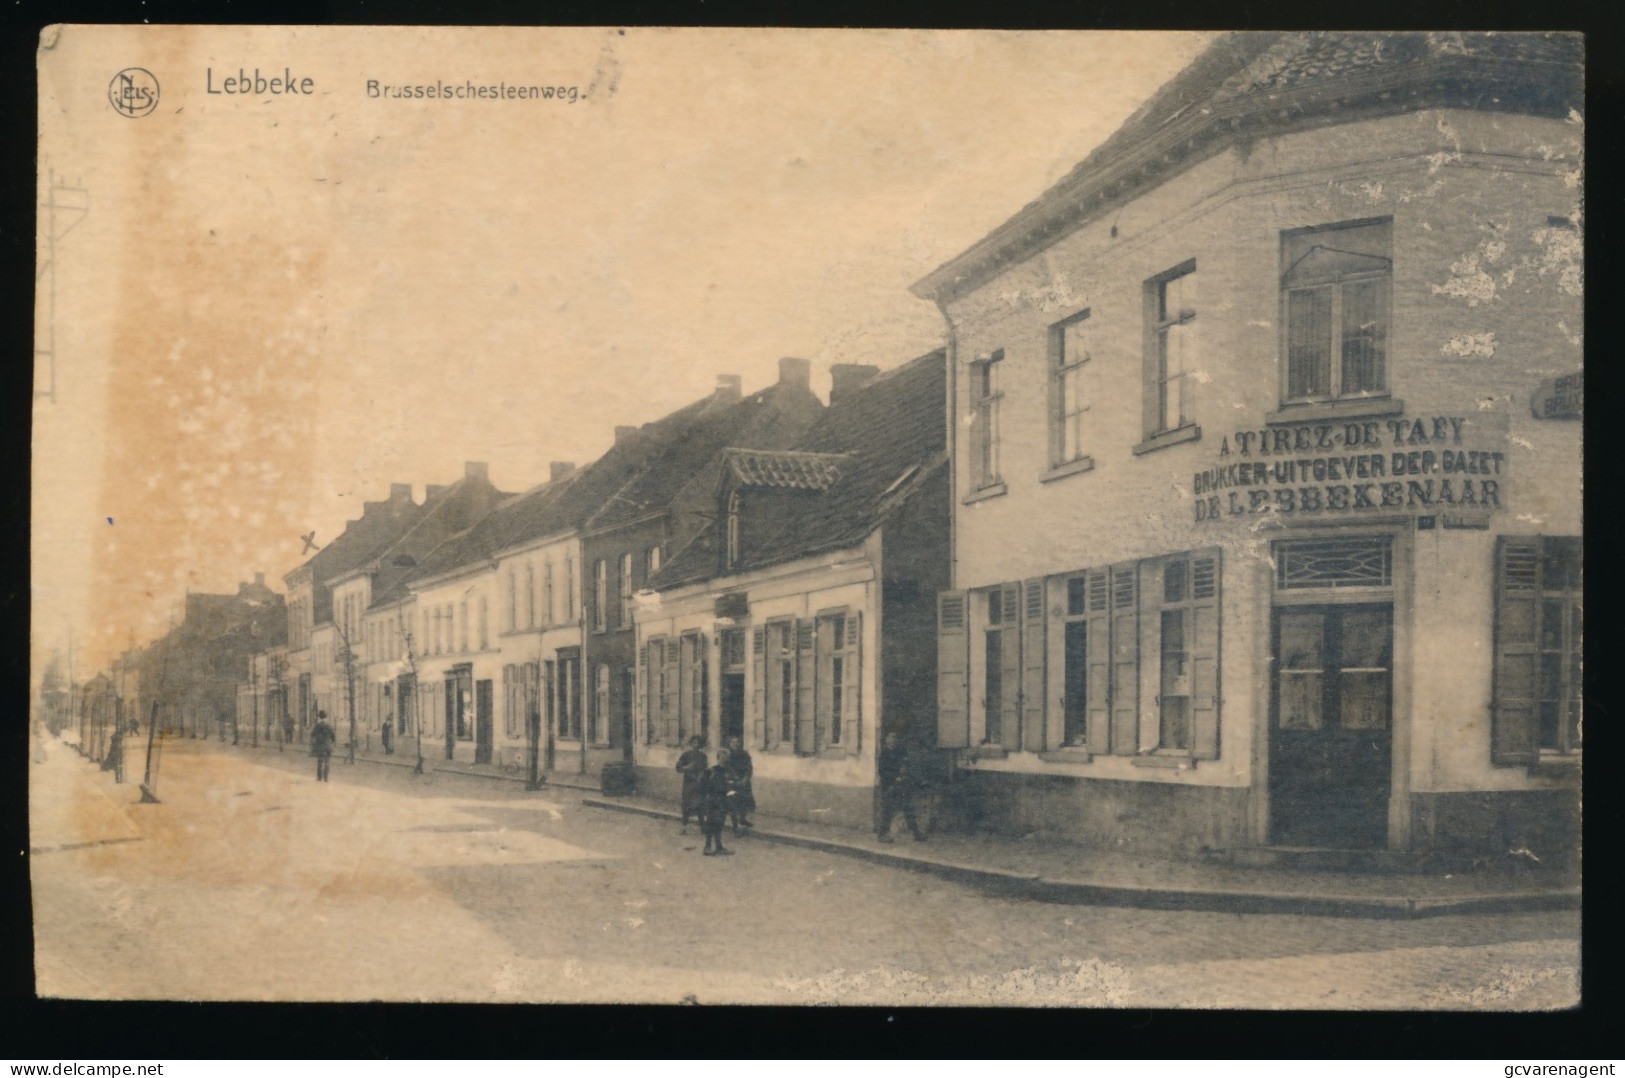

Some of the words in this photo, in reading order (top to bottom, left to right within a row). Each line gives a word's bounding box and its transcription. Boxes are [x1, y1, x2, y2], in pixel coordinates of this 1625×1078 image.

[1442, 449, 1504, 475] GAZET
[1194, 495, 1221, 523] DE
[1228, 478, 1502, 516] LEBBEKENAAR
